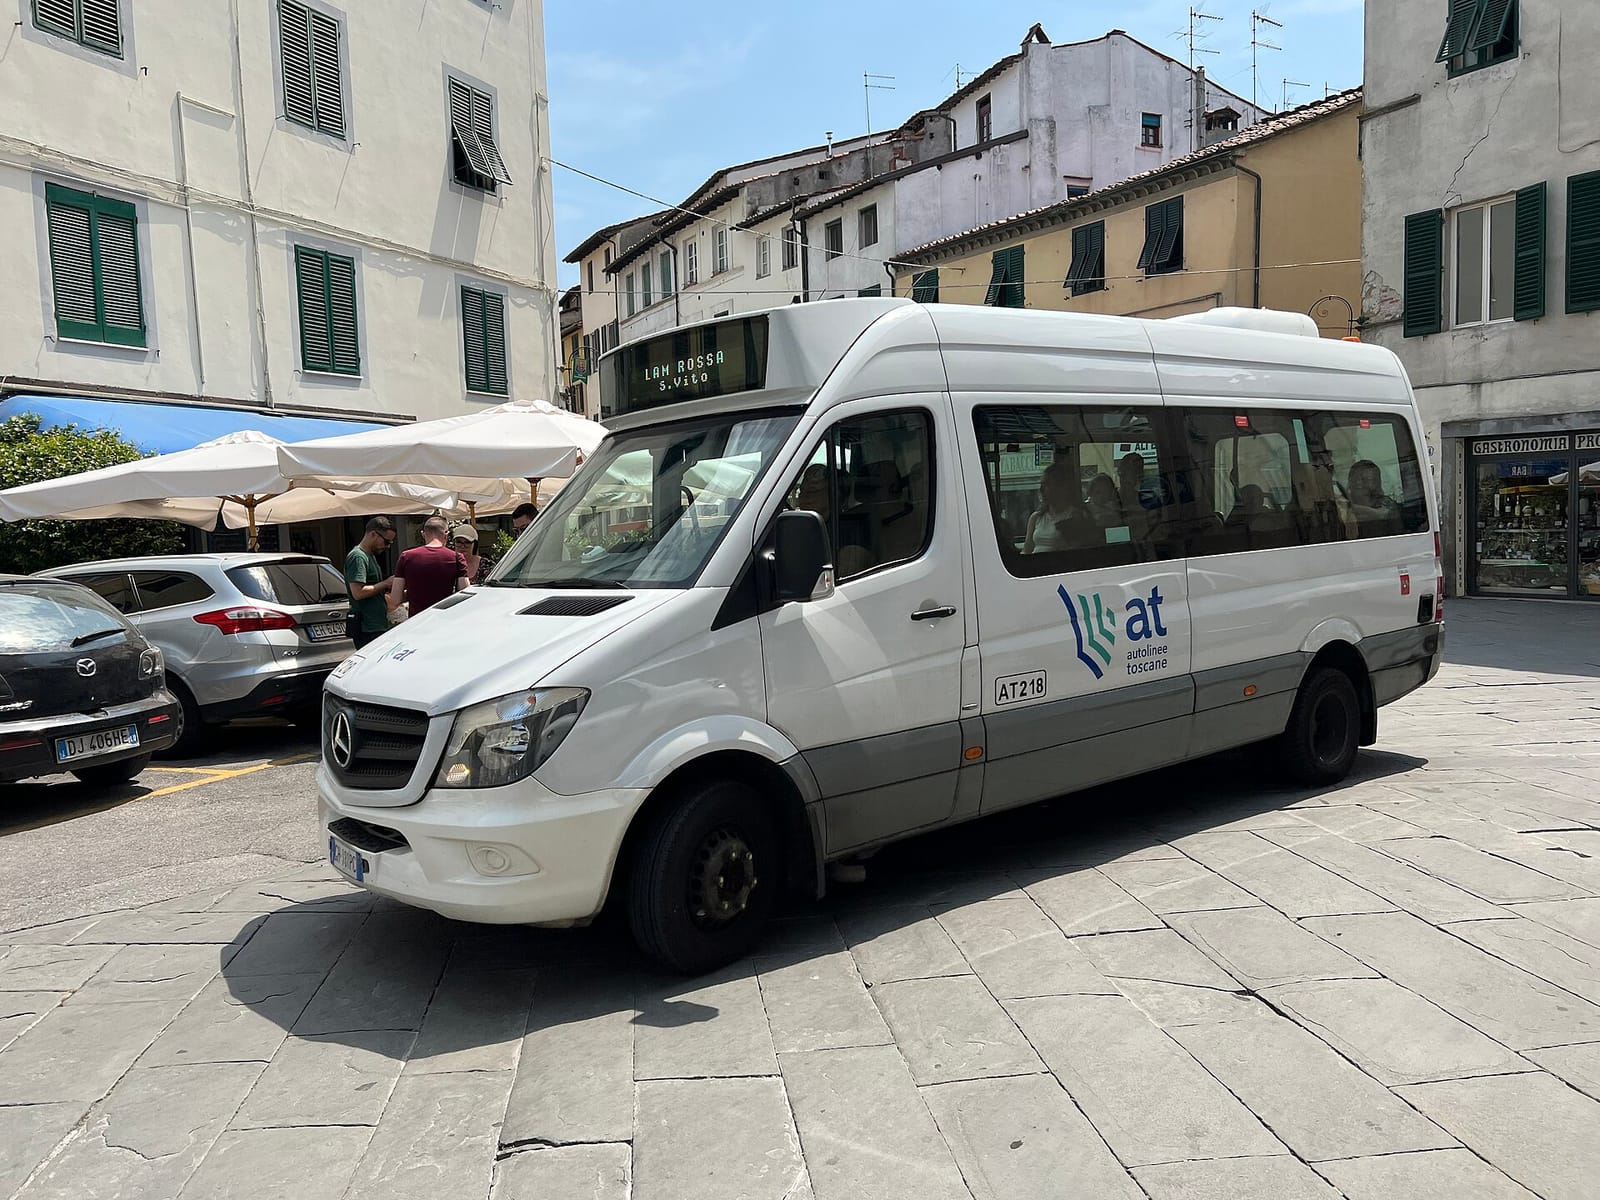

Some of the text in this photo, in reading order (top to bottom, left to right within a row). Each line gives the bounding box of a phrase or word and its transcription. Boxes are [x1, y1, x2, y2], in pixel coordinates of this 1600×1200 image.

[645, 350, 724, 381] LAM ROSSA
[659, 372, 708, 391] S.Vito
[1474, 437, 1569, 453] GASTRONOMIA
[1125, 585, 1168, 642] at
[1127, 643, 1168, 660] autolinee
[1127, 657, 1168, 676] toscane
[998, 677, 1044, 701] AT218
[66, 728, 130, 757] DJ 406HE
